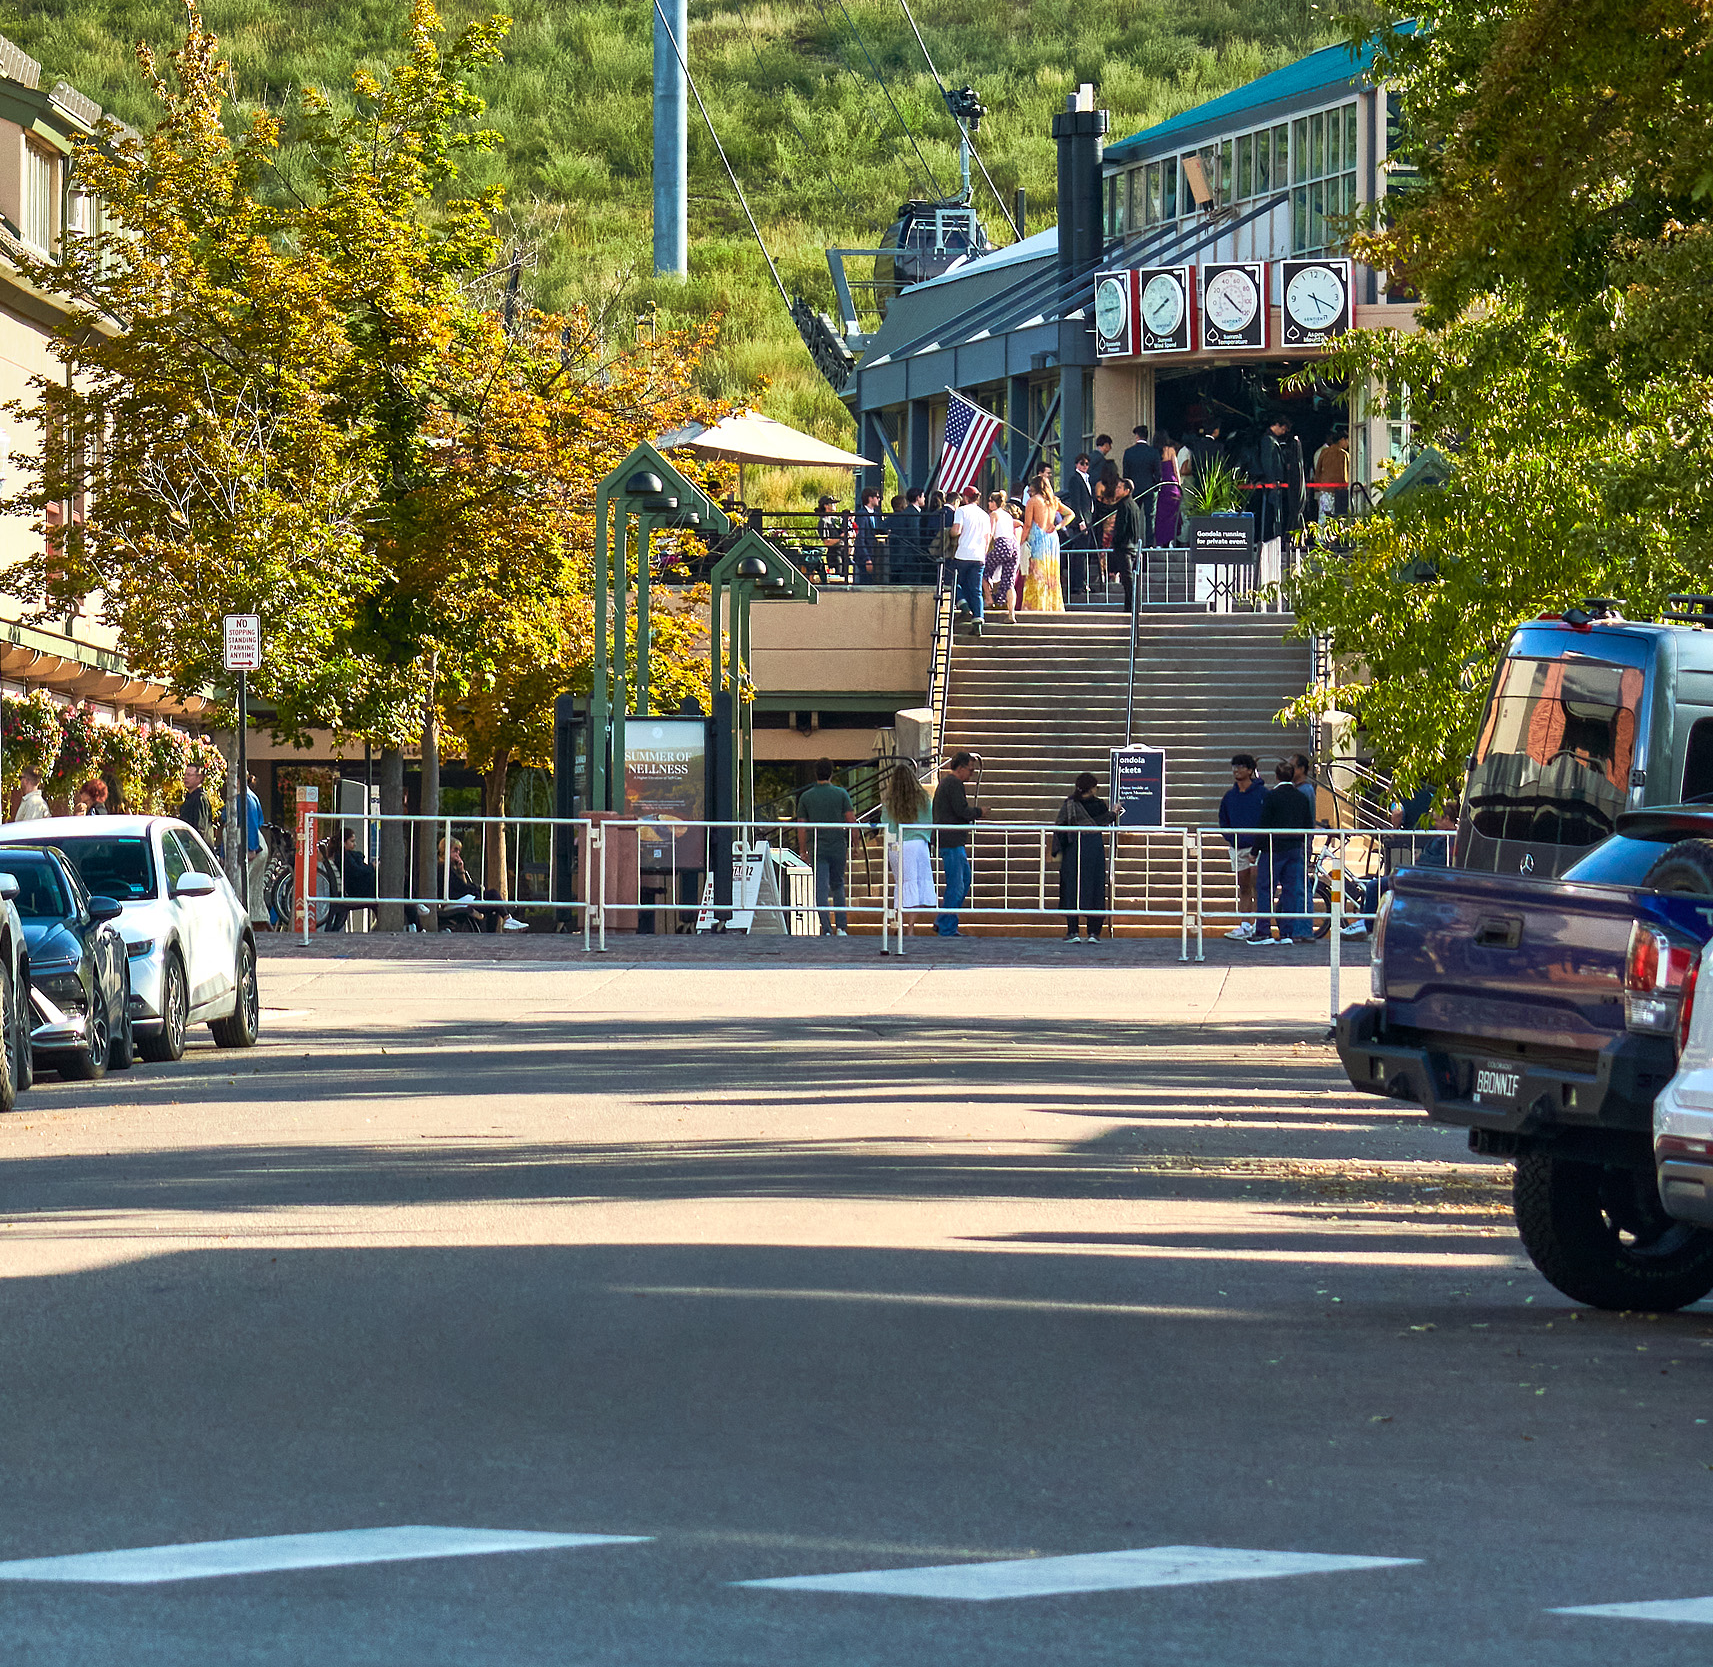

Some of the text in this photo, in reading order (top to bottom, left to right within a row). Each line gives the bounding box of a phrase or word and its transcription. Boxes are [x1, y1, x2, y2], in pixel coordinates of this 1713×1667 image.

[236, 619, 247, 628] NO
[625, 751, 691, 761] SUMMER OF
[1120, 756, 1145, 764] ondola
[628, 763, 688, 775] NELLNESS
